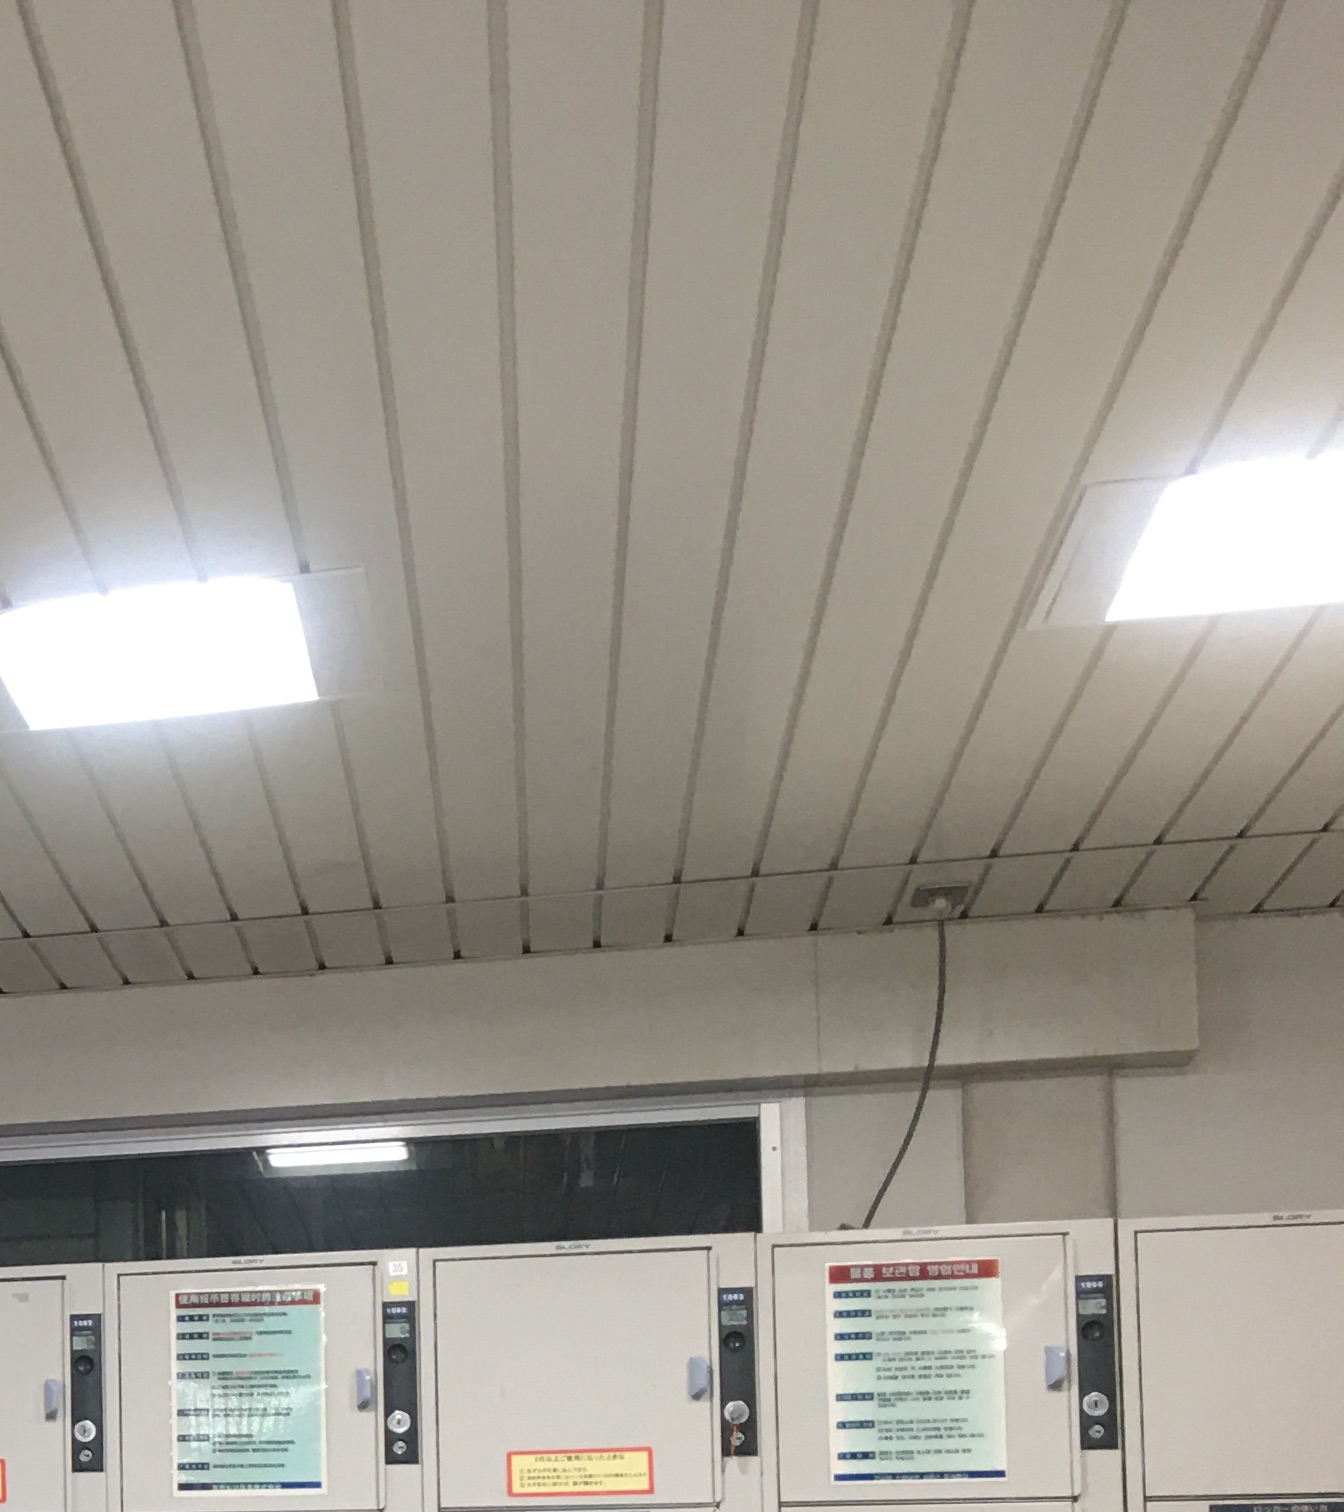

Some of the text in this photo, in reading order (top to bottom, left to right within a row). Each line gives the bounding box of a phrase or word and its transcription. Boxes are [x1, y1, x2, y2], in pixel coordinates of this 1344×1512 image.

[392, 1263, 403, 1273] 35
[1253, 1505, 1328, 1512] ロッカーの使い方
